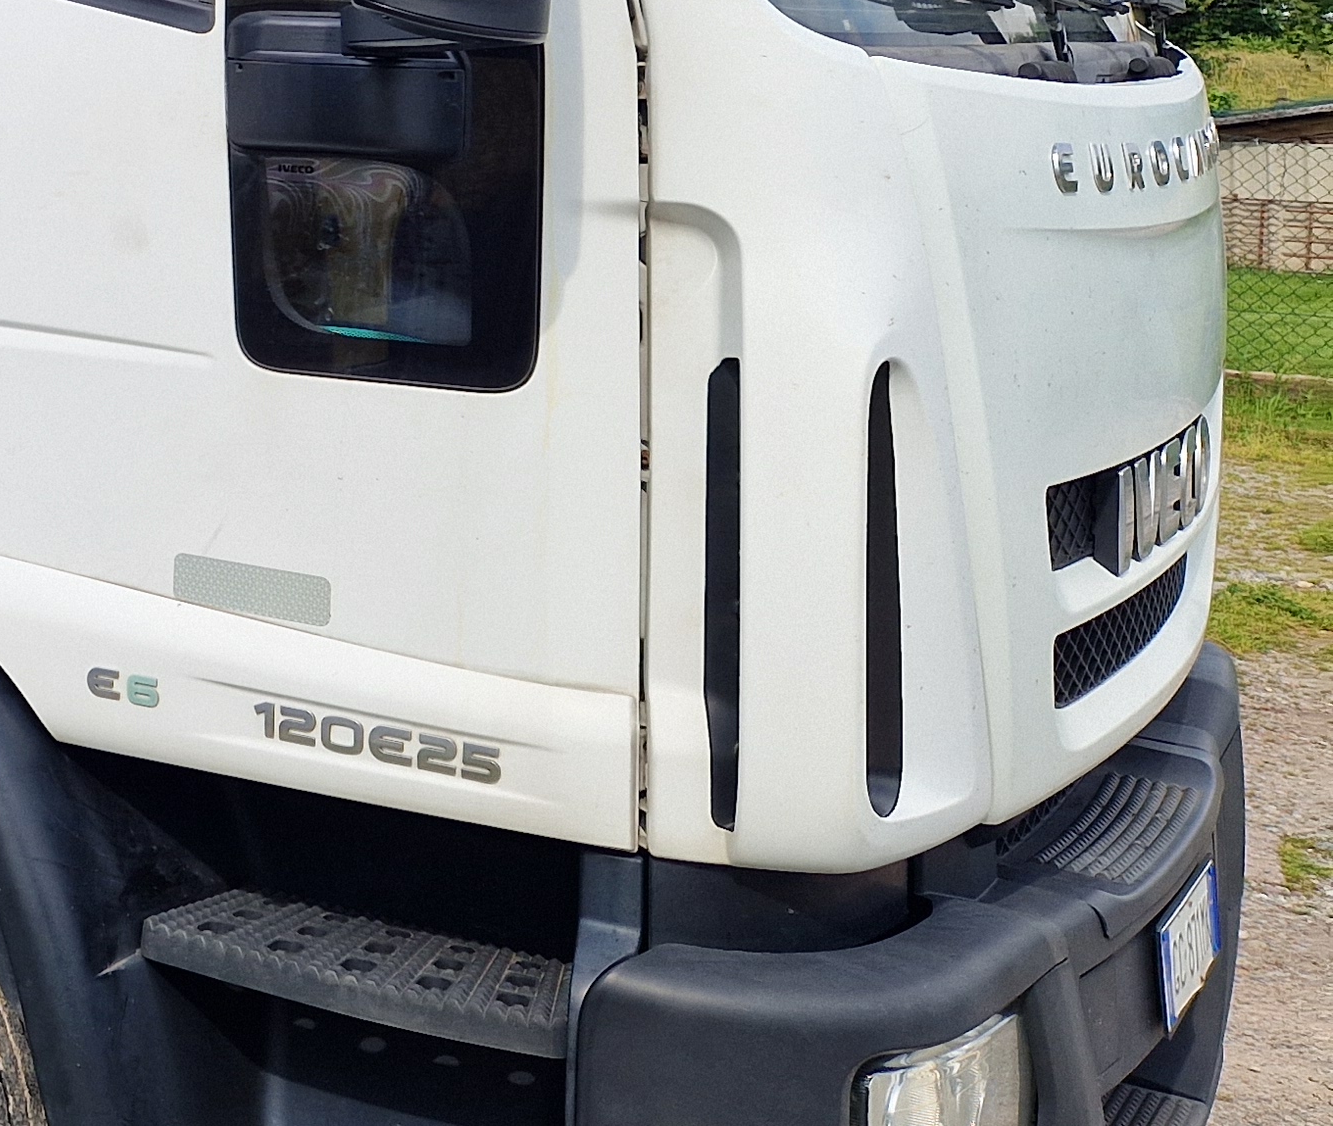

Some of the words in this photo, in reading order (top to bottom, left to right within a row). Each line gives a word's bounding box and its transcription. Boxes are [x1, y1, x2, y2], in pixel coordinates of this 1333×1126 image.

[278, 164, 314, 174] IVECO
[1118, 415, 1210, 578] IVECO
[86, 666, 160, 709] E6
[252, 701, 503, 786] 120E25
